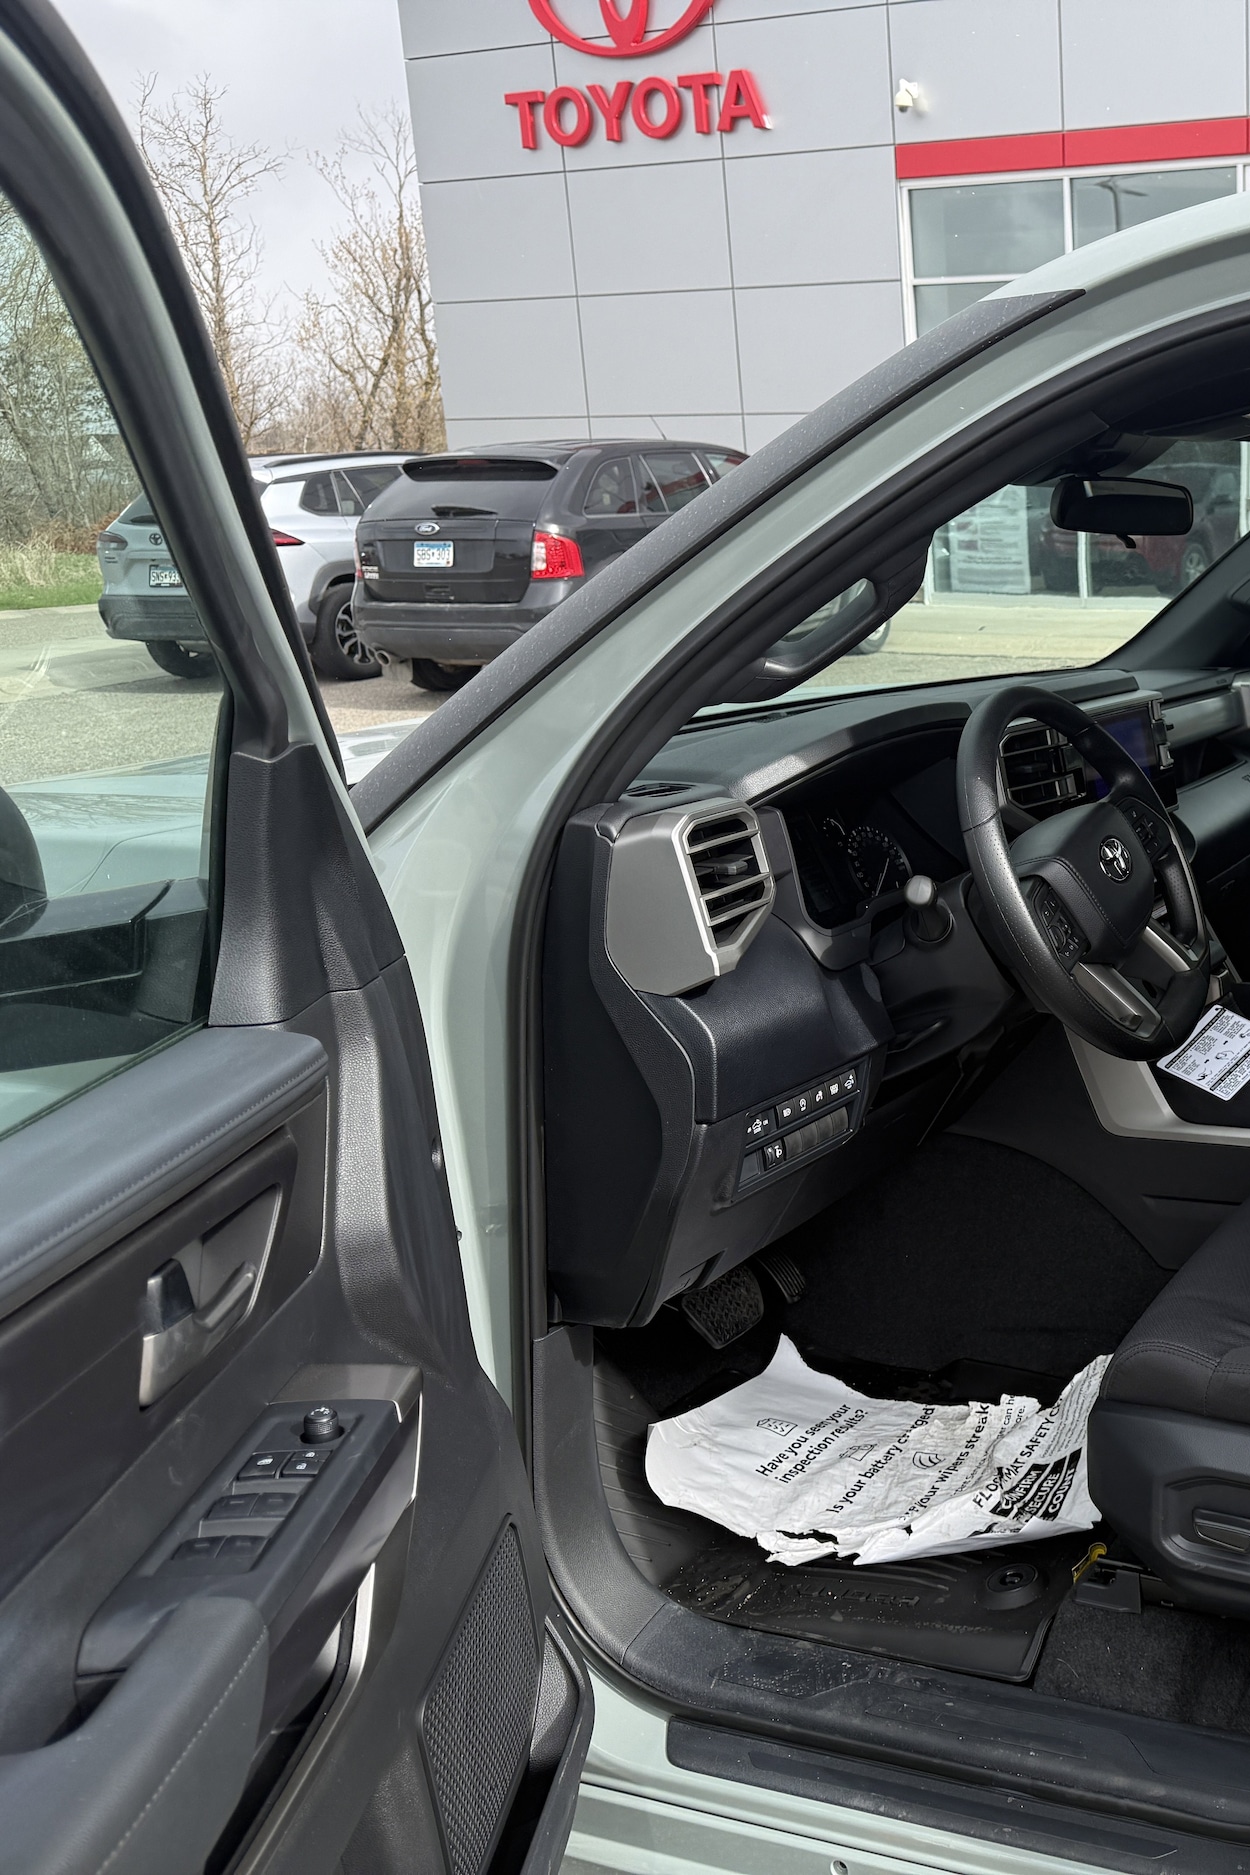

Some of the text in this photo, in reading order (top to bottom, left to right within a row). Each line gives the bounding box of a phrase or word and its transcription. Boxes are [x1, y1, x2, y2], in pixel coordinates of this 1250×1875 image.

[504, 69, 772, 150] TOYOTA
[755, 1404, 851, 1476] Have you seen your
[775, 1408, 868, 1484] inspection results?
[1003, 1408, 1013, 1426] can
[825, 1407, 935, 1514] Is your battery crged
[914, 1485, 940, 1508] your
[936, 1451, 969, 1482] wipers
[972, 1472, 1002, 1508] FLO
[1003, 1458, 1026, 1480] MAT
[1020, 1417, 1055, 1458] SAFETY
[1025, 1473, 1060, 1513] SECURE
[1048, 1468, 1074, 1513] COUNT
